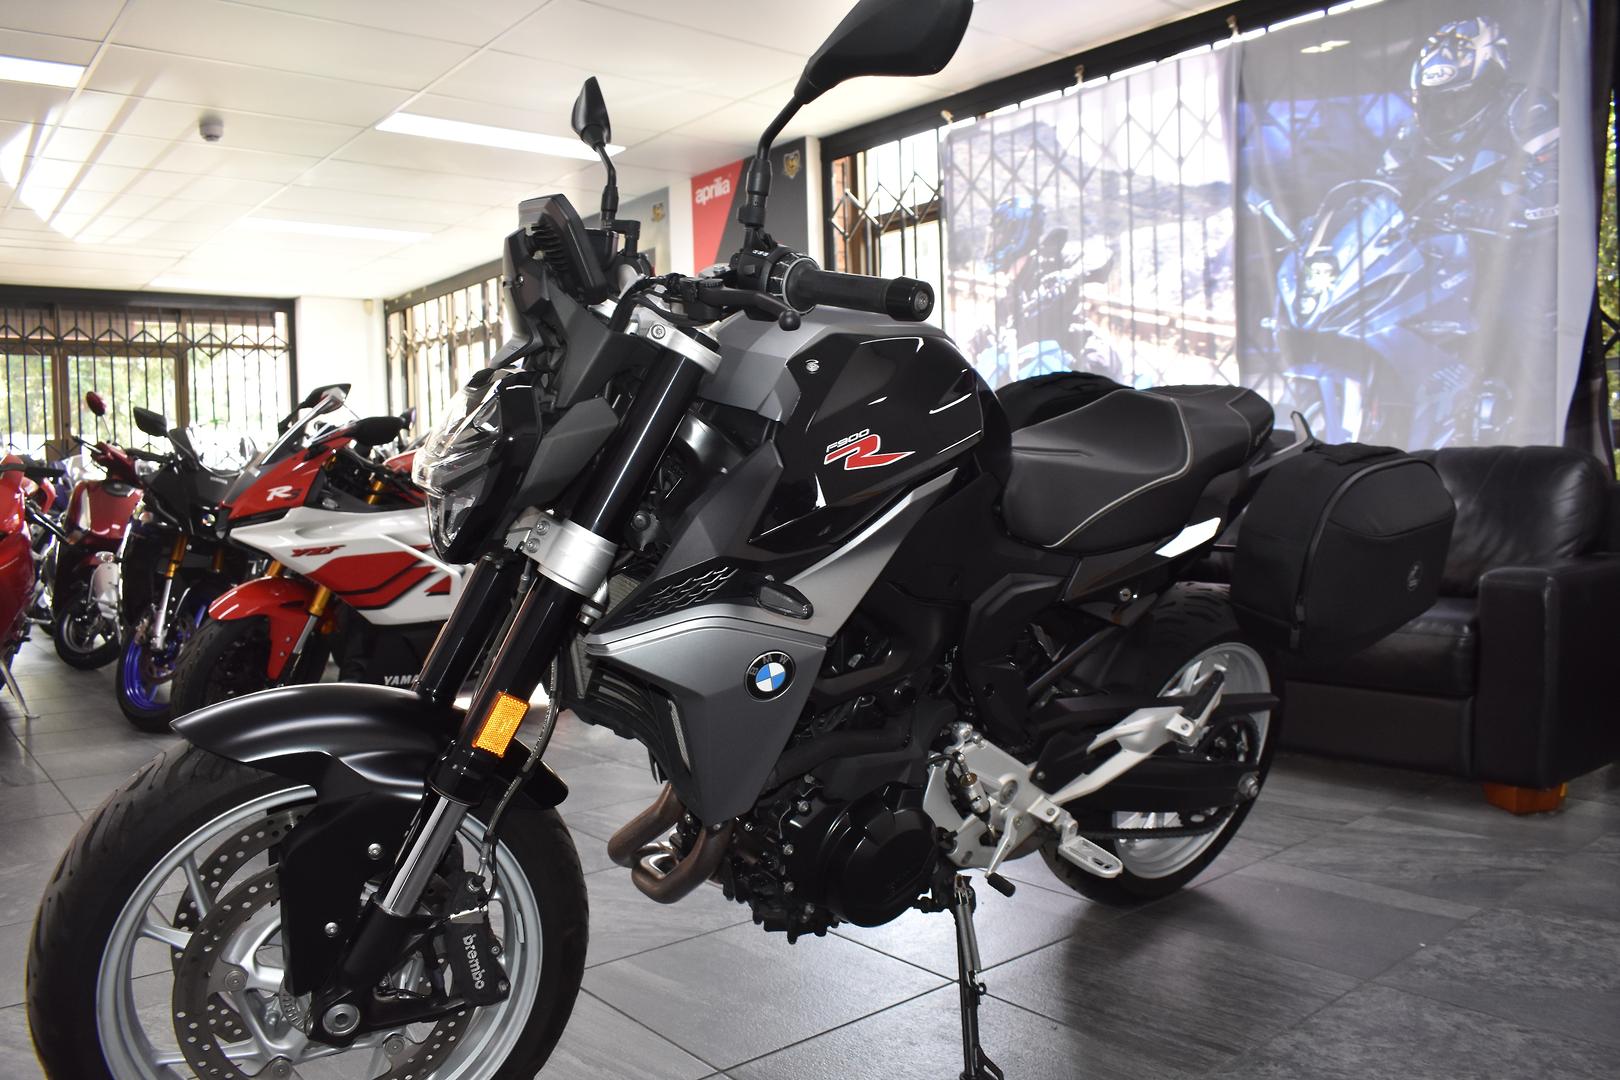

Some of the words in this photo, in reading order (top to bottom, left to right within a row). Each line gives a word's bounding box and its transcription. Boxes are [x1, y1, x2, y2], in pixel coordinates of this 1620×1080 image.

[695, 176, 731, 206] aprilia
[826, 428, 870, 452] F900
[749, 654, 789, 676] BMW
[462, 933, 486, 990] brembo
